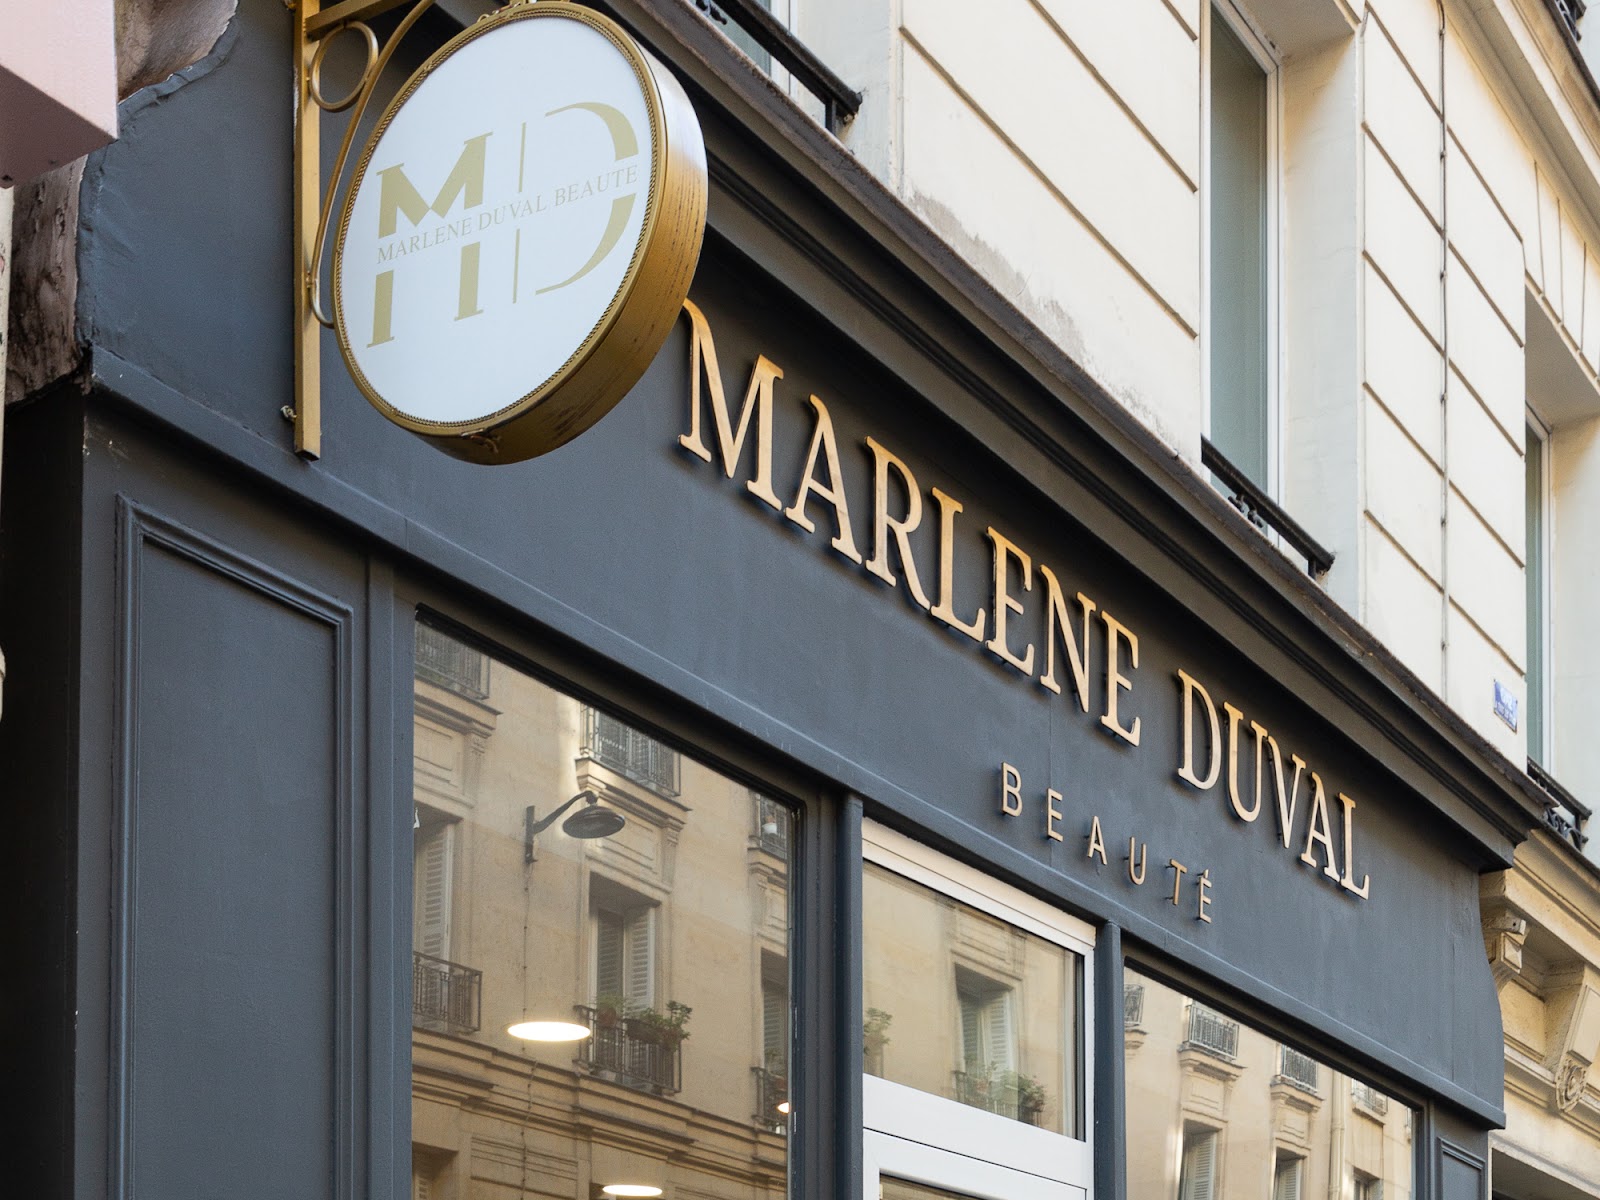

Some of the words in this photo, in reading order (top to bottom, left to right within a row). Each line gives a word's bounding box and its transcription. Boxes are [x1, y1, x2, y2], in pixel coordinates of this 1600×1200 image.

[377, 217, 472, 265] MARLENE
[478, 194, 547, 231] DUVAL
[554, 164, 639, 207] BEAUTE
[679, 298, 1141, 747] MARLENE
[1176, 668, 1370, 900] DUVAL
[1001, 761, 1213, 925] BEAUTÉ
